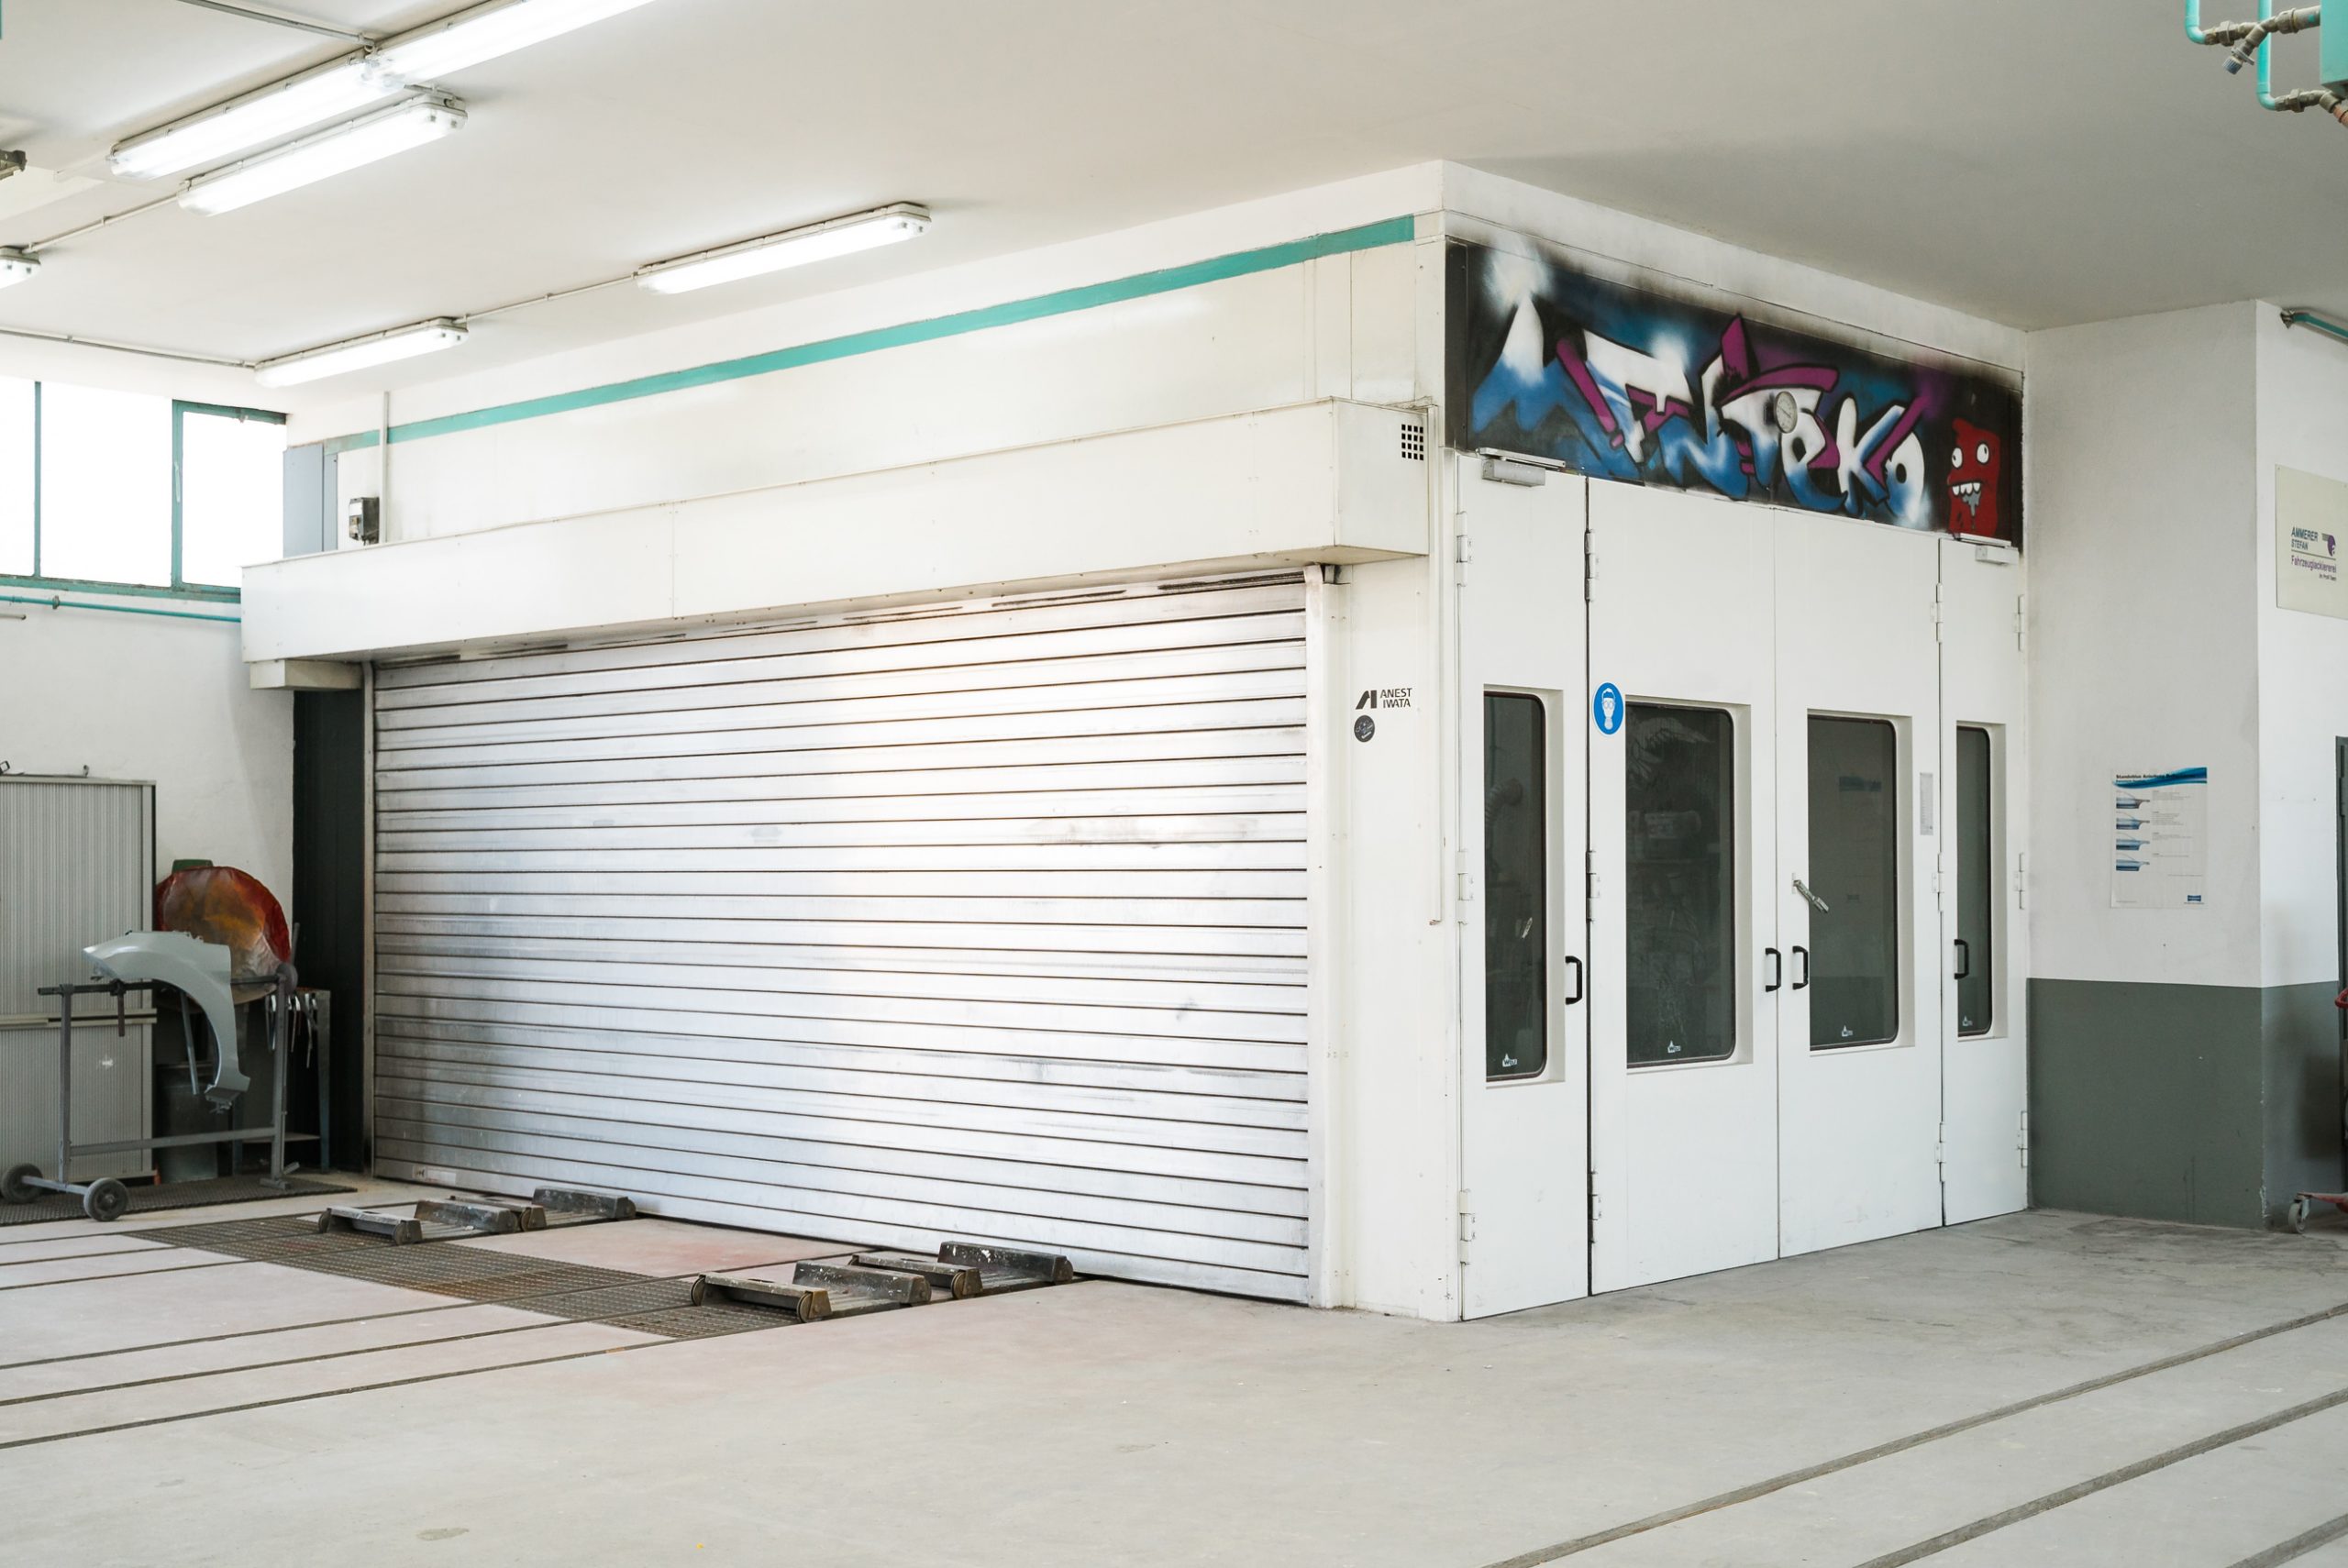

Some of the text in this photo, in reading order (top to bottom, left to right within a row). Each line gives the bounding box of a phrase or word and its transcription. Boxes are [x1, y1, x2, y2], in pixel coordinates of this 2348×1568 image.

[2291, 538, 2309, 550] STEFAN
[1380, 688, 1412, 698] ANEST
[1383, 699, 1411, 709] IWATA
